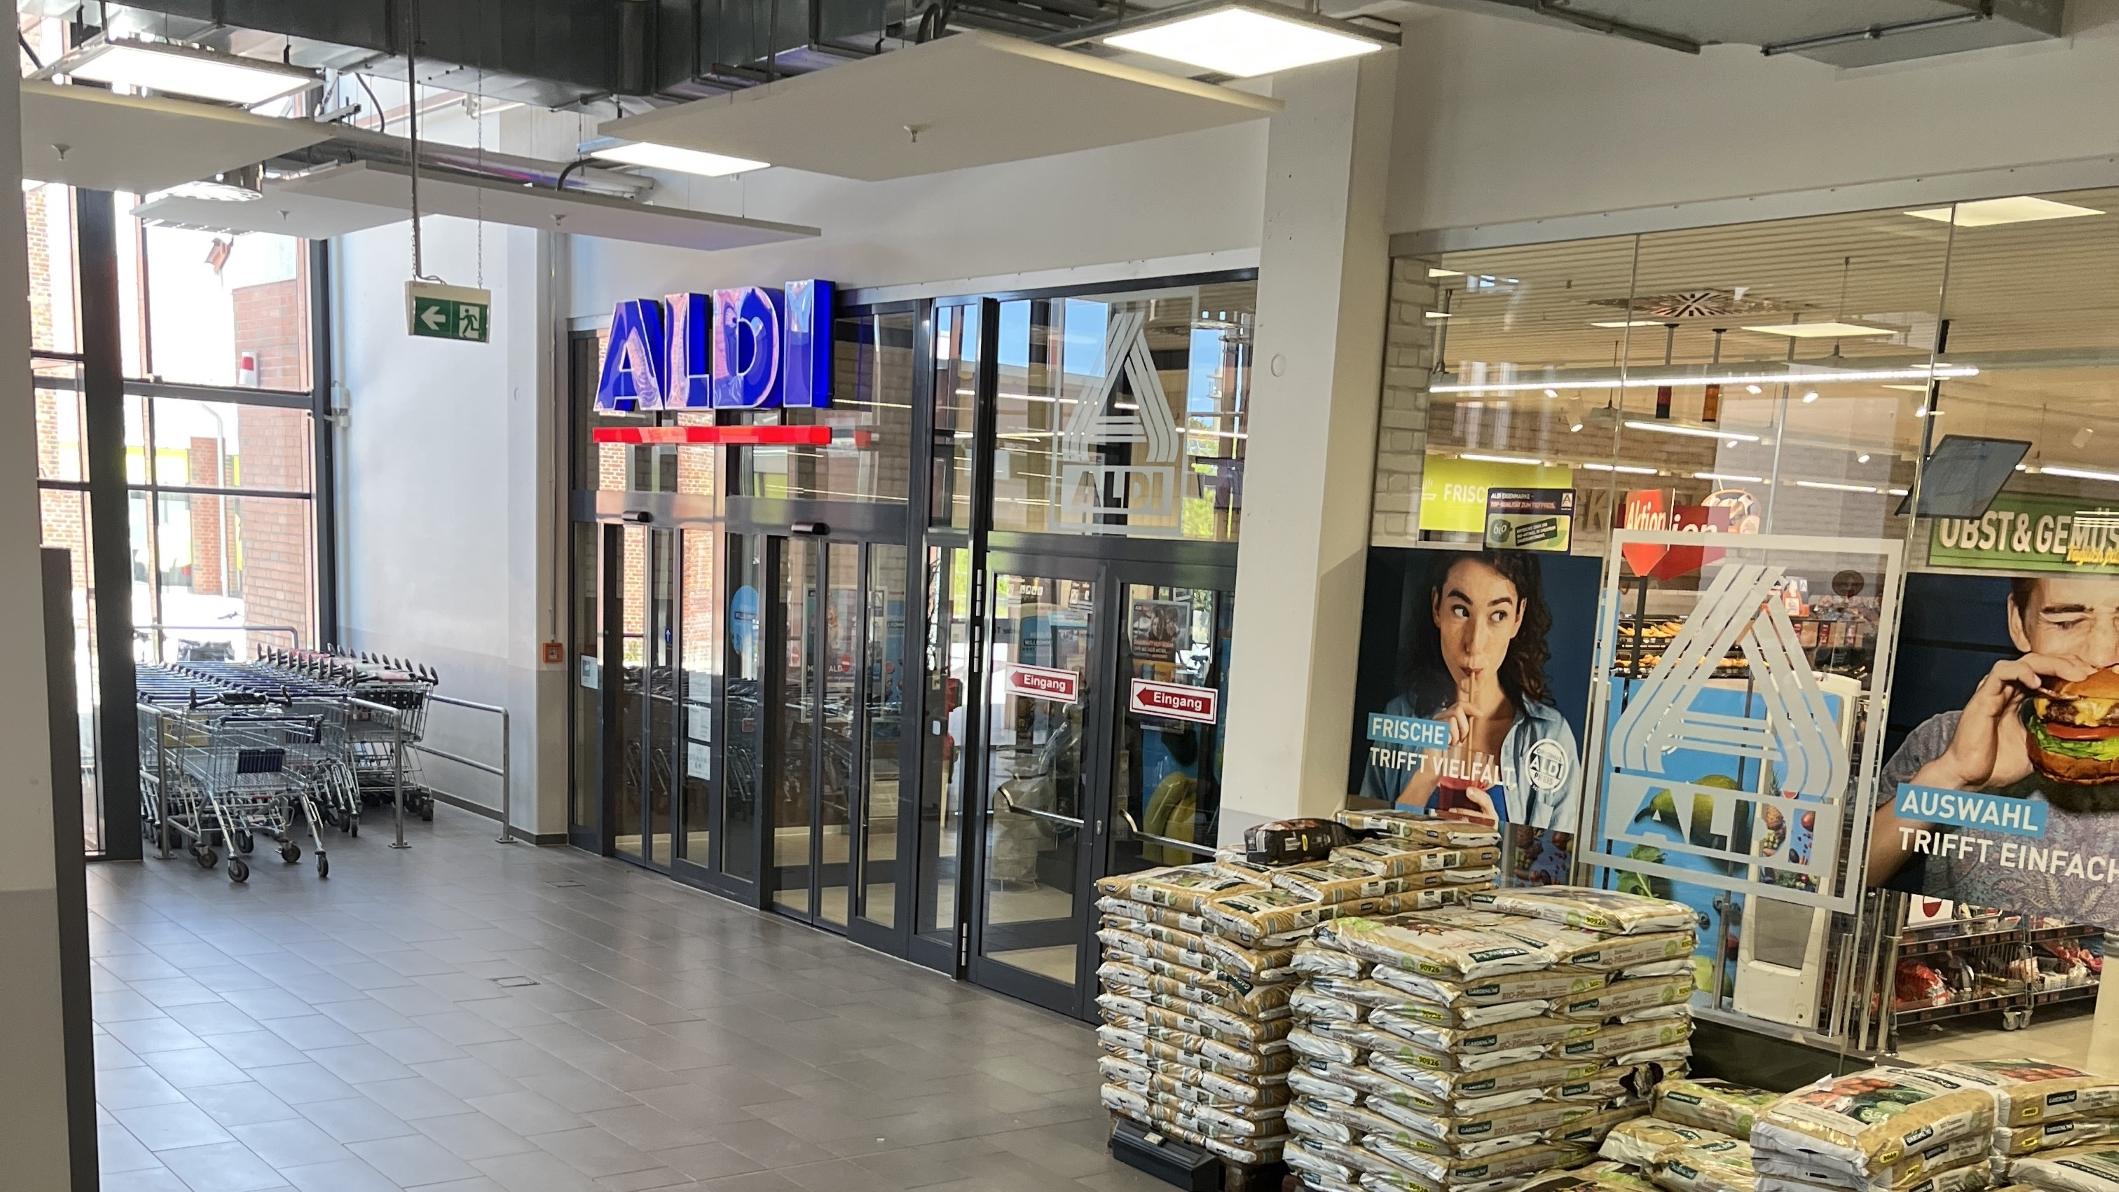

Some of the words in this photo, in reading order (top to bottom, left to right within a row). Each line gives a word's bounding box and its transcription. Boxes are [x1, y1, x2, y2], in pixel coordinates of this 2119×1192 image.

[593, 279, 835, 411] ALDI
[1072, 470, 1164, 508] ALDI
[1626, 500, 1667, 531] Aktion
[1939, 511, 2014, 550] OBST
[2011, 513, 2032, 552] &
[1023, 674, 1066, 692] Eingang
[1153, 691, 1203, 711] Eingang
[1372, 717, 1446, 745] FRISCHE
[1370, 747, 1428, 774] TRIFFT
[1625, 786, 1816, 865] ALDI
[1901, 790, 2038, 831] AUSWAHL
[1898, 827, 1993, 863] TRIFFT
